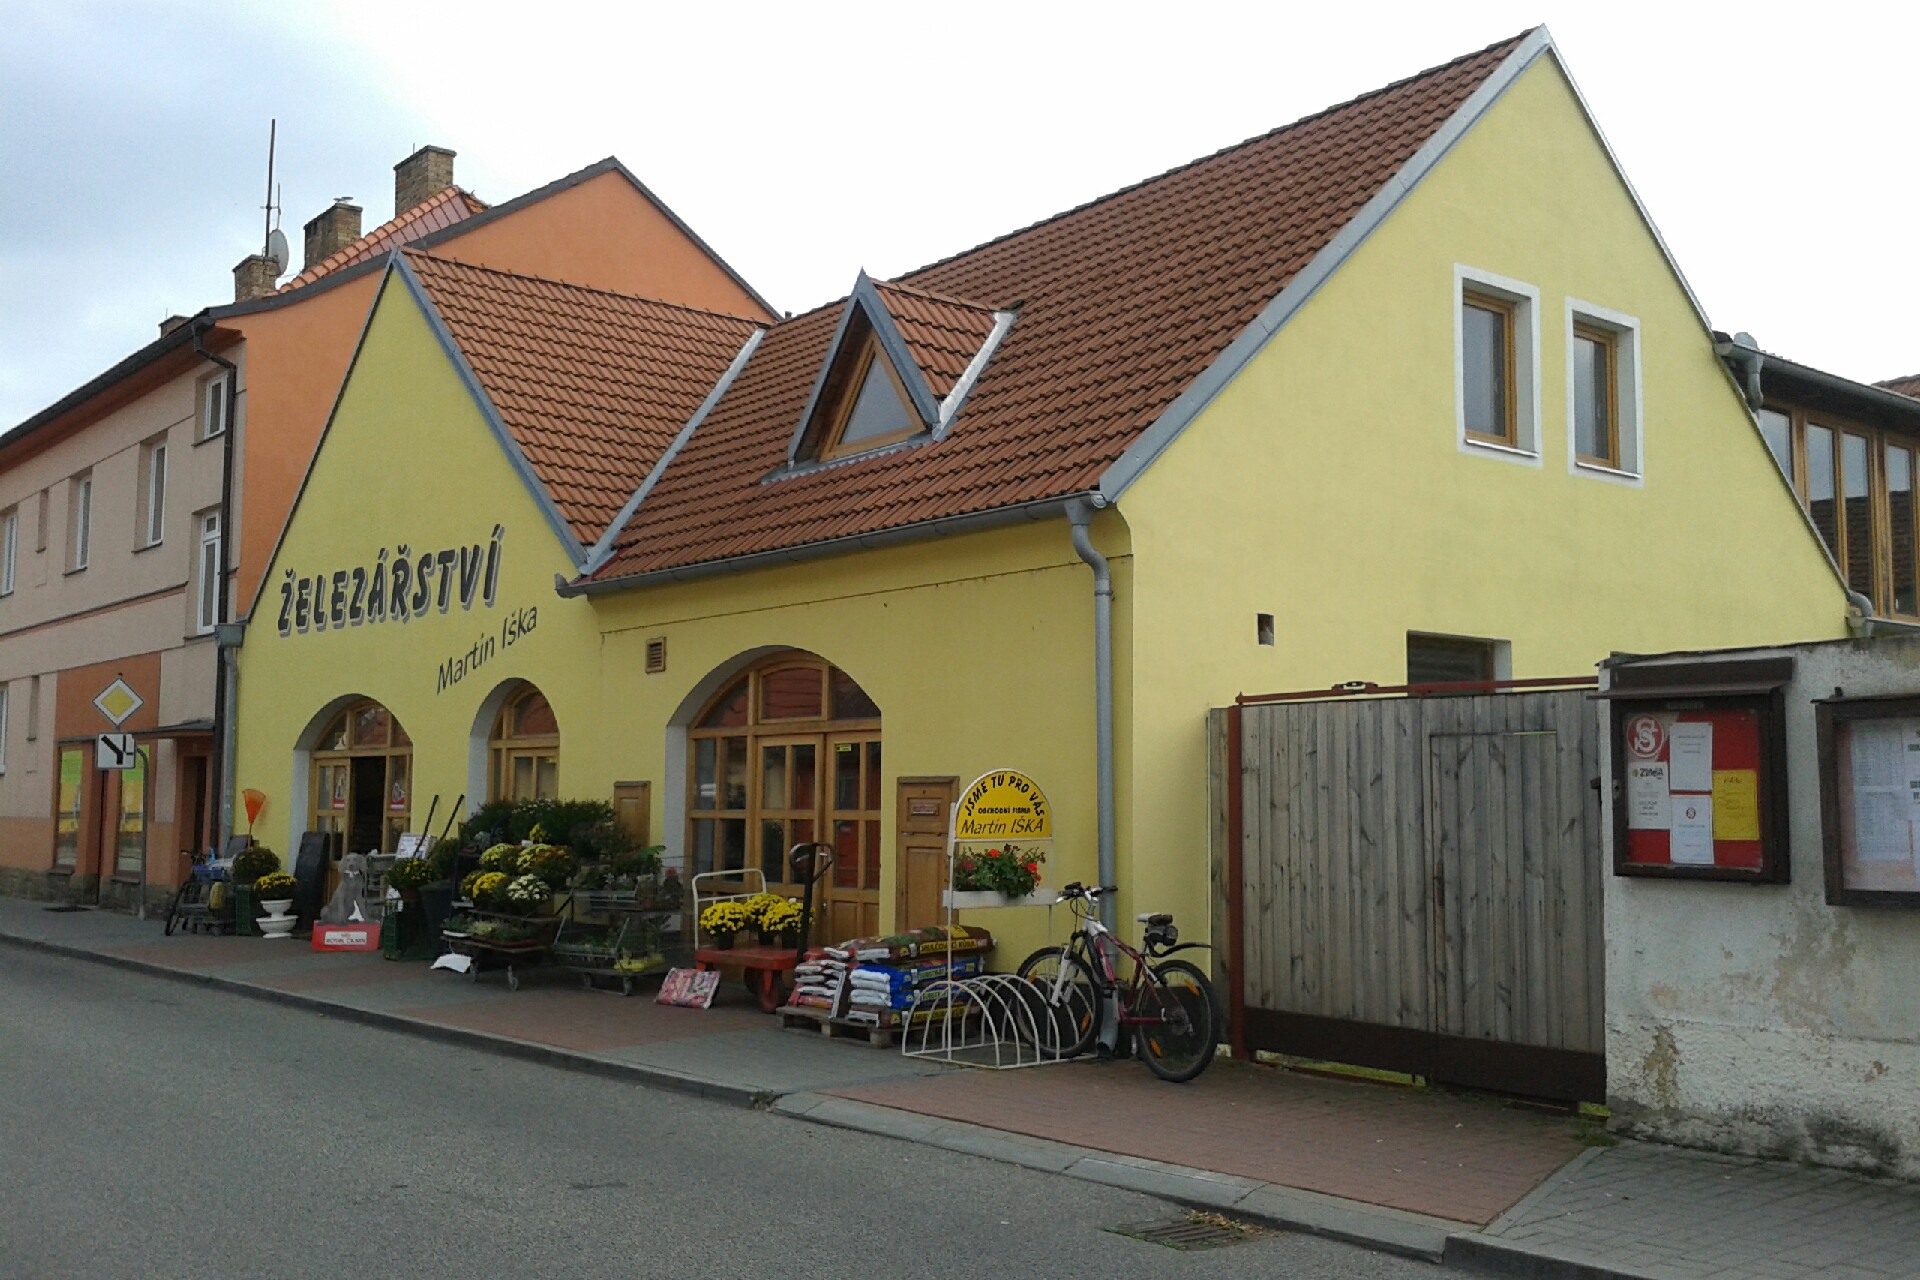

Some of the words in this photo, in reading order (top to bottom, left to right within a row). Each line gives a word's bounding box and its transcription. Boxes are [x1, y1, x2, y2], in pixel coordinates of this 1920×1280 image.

[278, 523, 505, 638] ŽELEZÁŘSTVÍ
[436, 632, 495, 696] Martin
[501, 605, 538, 650] Iška
[961, 819, 1006, 834] Martin
[1011, 816, 1043, 833] IŠKA
[965, 782, 987, 816] JSME
[991, 773, 1005, 788] TU
[1009, 776, 1029, 792] PRO
[1030, 793, 1044, 816] VÁS
